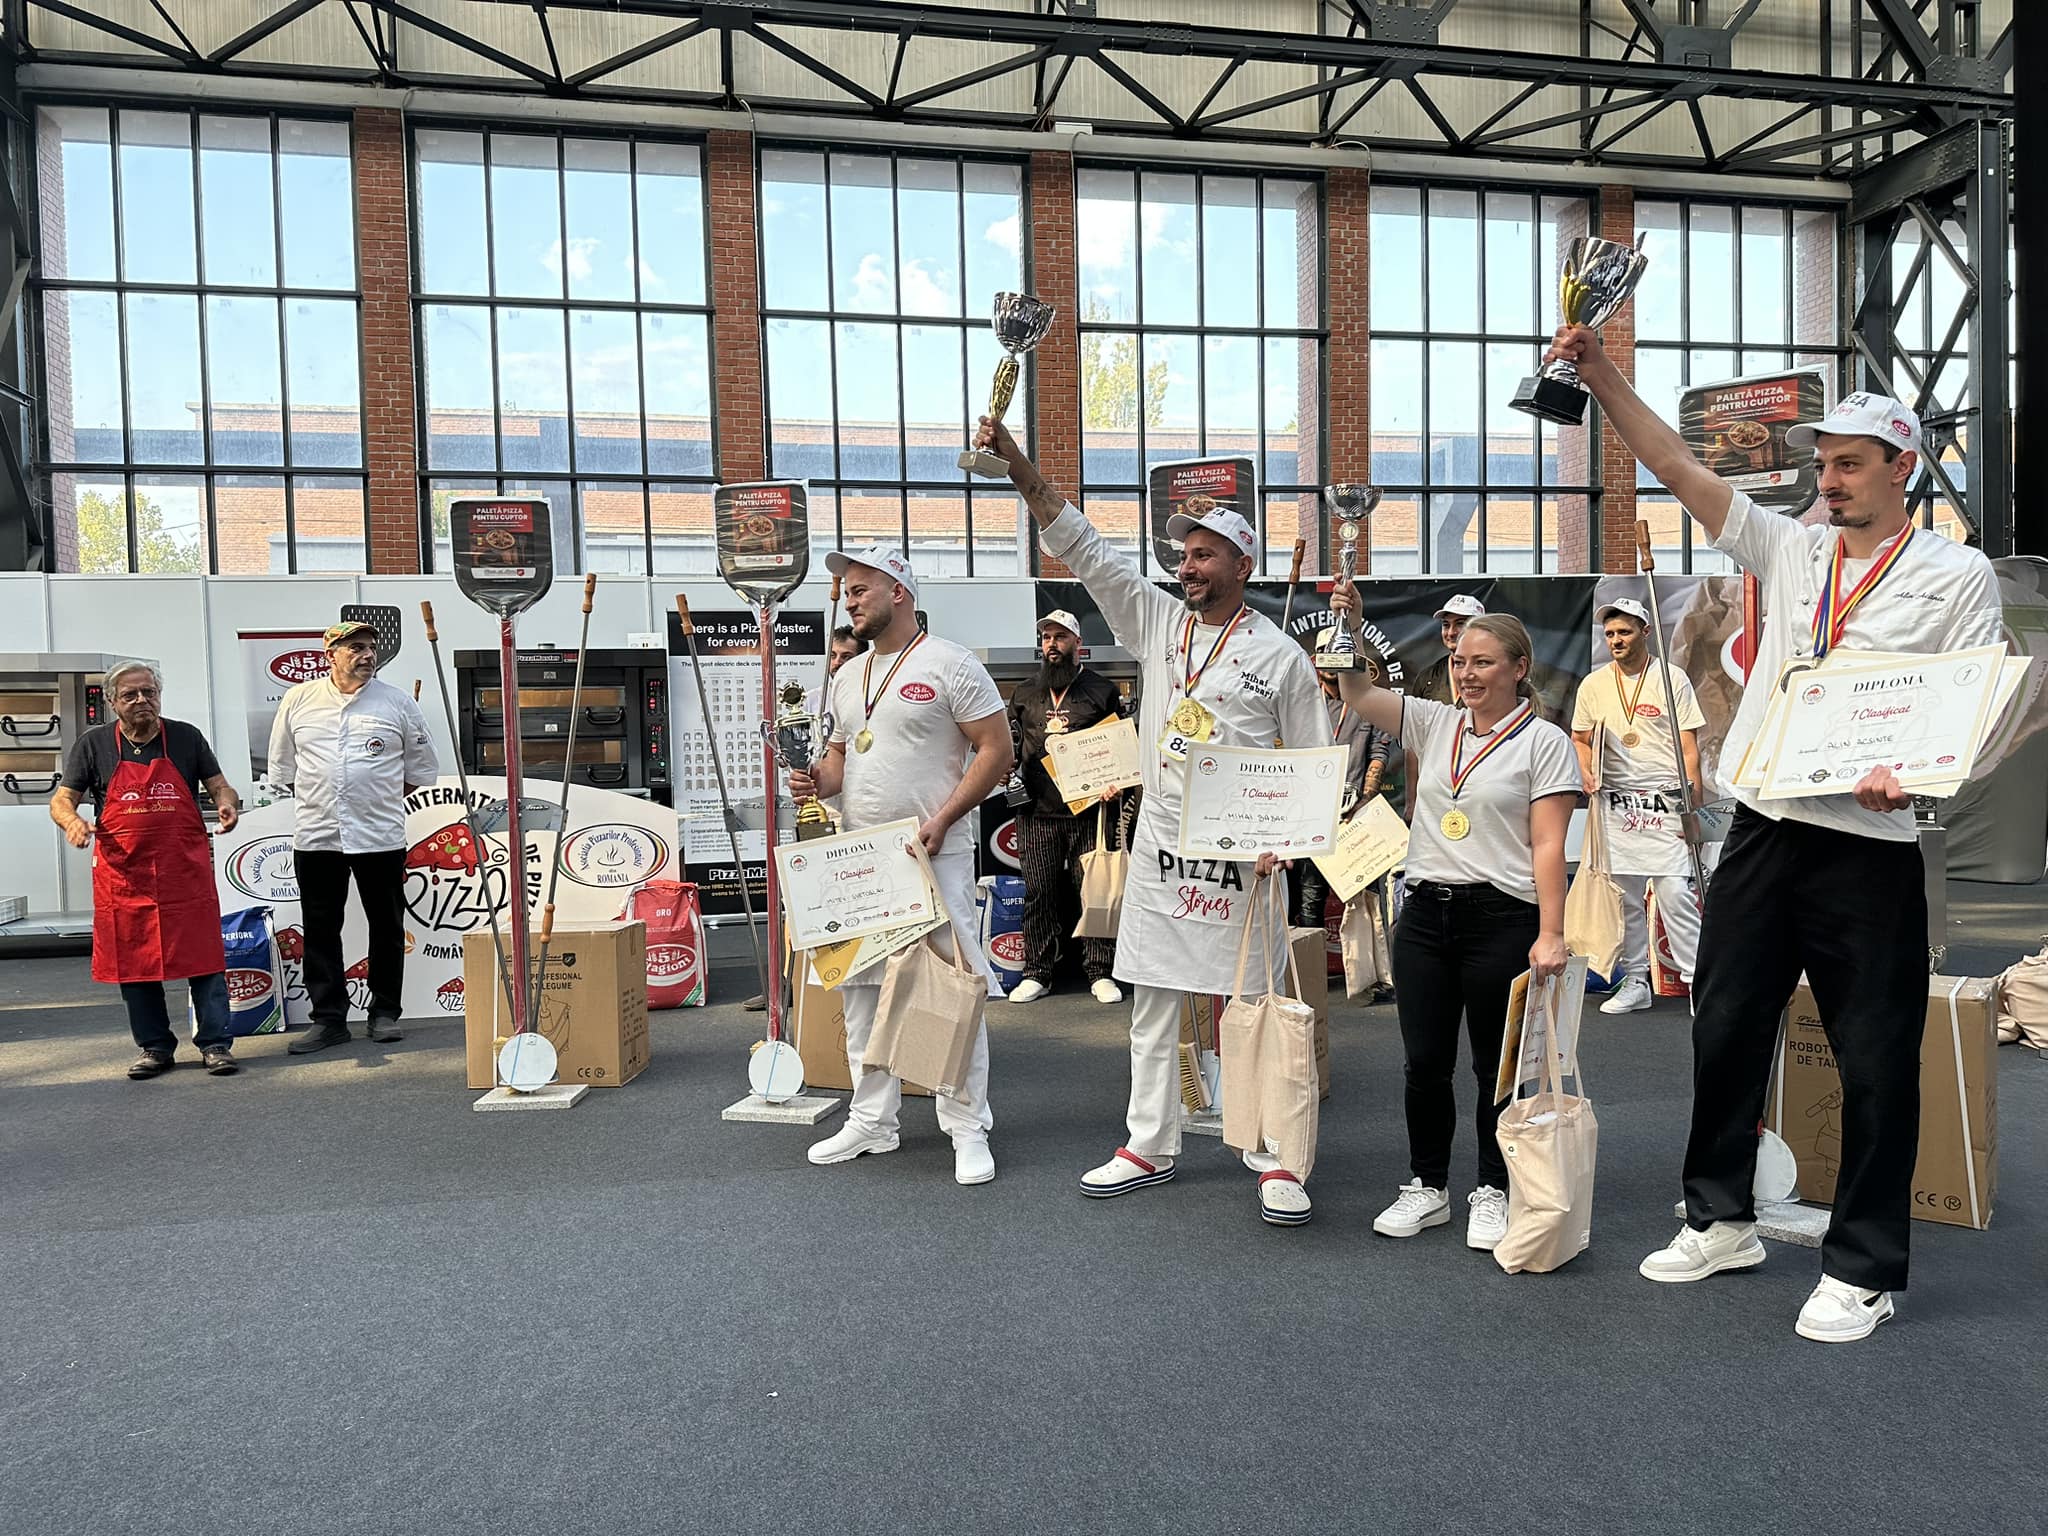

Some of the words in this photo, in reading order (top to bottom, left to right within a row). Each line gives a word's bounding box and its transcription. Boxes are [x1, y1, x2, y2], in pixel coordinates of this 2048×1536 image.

[1716, 388, 1754, 403] PALETĂ
[1754, 385, 1784, 397] PIZZA
[1710, 400, 1749, 413] PENTRU
[1749, 394, 1791, 407] CUPTOR
[1205, 468, 1226, 476] PIZZA
[1173, 477, 1201, 487] PENTRU
[1201, 475, 1231, 484] CUPTOR
[760, 498, 786, 506] CUPTOR
[717, 623, 728, 634] is
[730, 624, 738, 634] a
[707, 637, 724, 647] for
[726, 639, 758, 649] every
[303, 657, 317, 670] 5
[1386, 661, 1404, 682] DE
[1241, 671, 1269, 687] Mihai
[1853, 673, 1924, 693] DIPLOMA
[1243, 681, 1274, 699] Babari
[1858, 704, 1912, 721] Clasificat
[1827, 739, 1851, 750] ALIN
[1239, 762, 1295, 774] DIPLOMA
[1248, 788, 1289, 800] Clasificat
[1227, 813, 1253, 822] MIHAI
[260, 842, 294, 858] Pizzarilo
[826, 842, 874, 860] DIPLOMA
[840, 866, 876, 881] Clasificat
[1158, 849, 1243, 892] PIZZA
[270, 887, 300, 898] ROMANI
[1171, 885, 1235, 921] Stories
[656, 908, 672, 917] ORO
[222, 931, 255, 941] PERIORE
[1015, 939, 1025, 949] 5
[658, 952, 670, 964] 5
[996, 944, 1025, 961] Stag
[646, 956, 692, 976] tagioni
[229, 976, 243, 988] 5
[542, 982, 573, 990] LEGUME
[1790, 1041, 1830, 1055] ROBOT
[1797, 1055, 1813, 1066] DE
[1816, 1057, 1835, 1068] TAI
[577, 1067, 591, 1078] CE
[1915, 1191, 1937, 1207] CE
